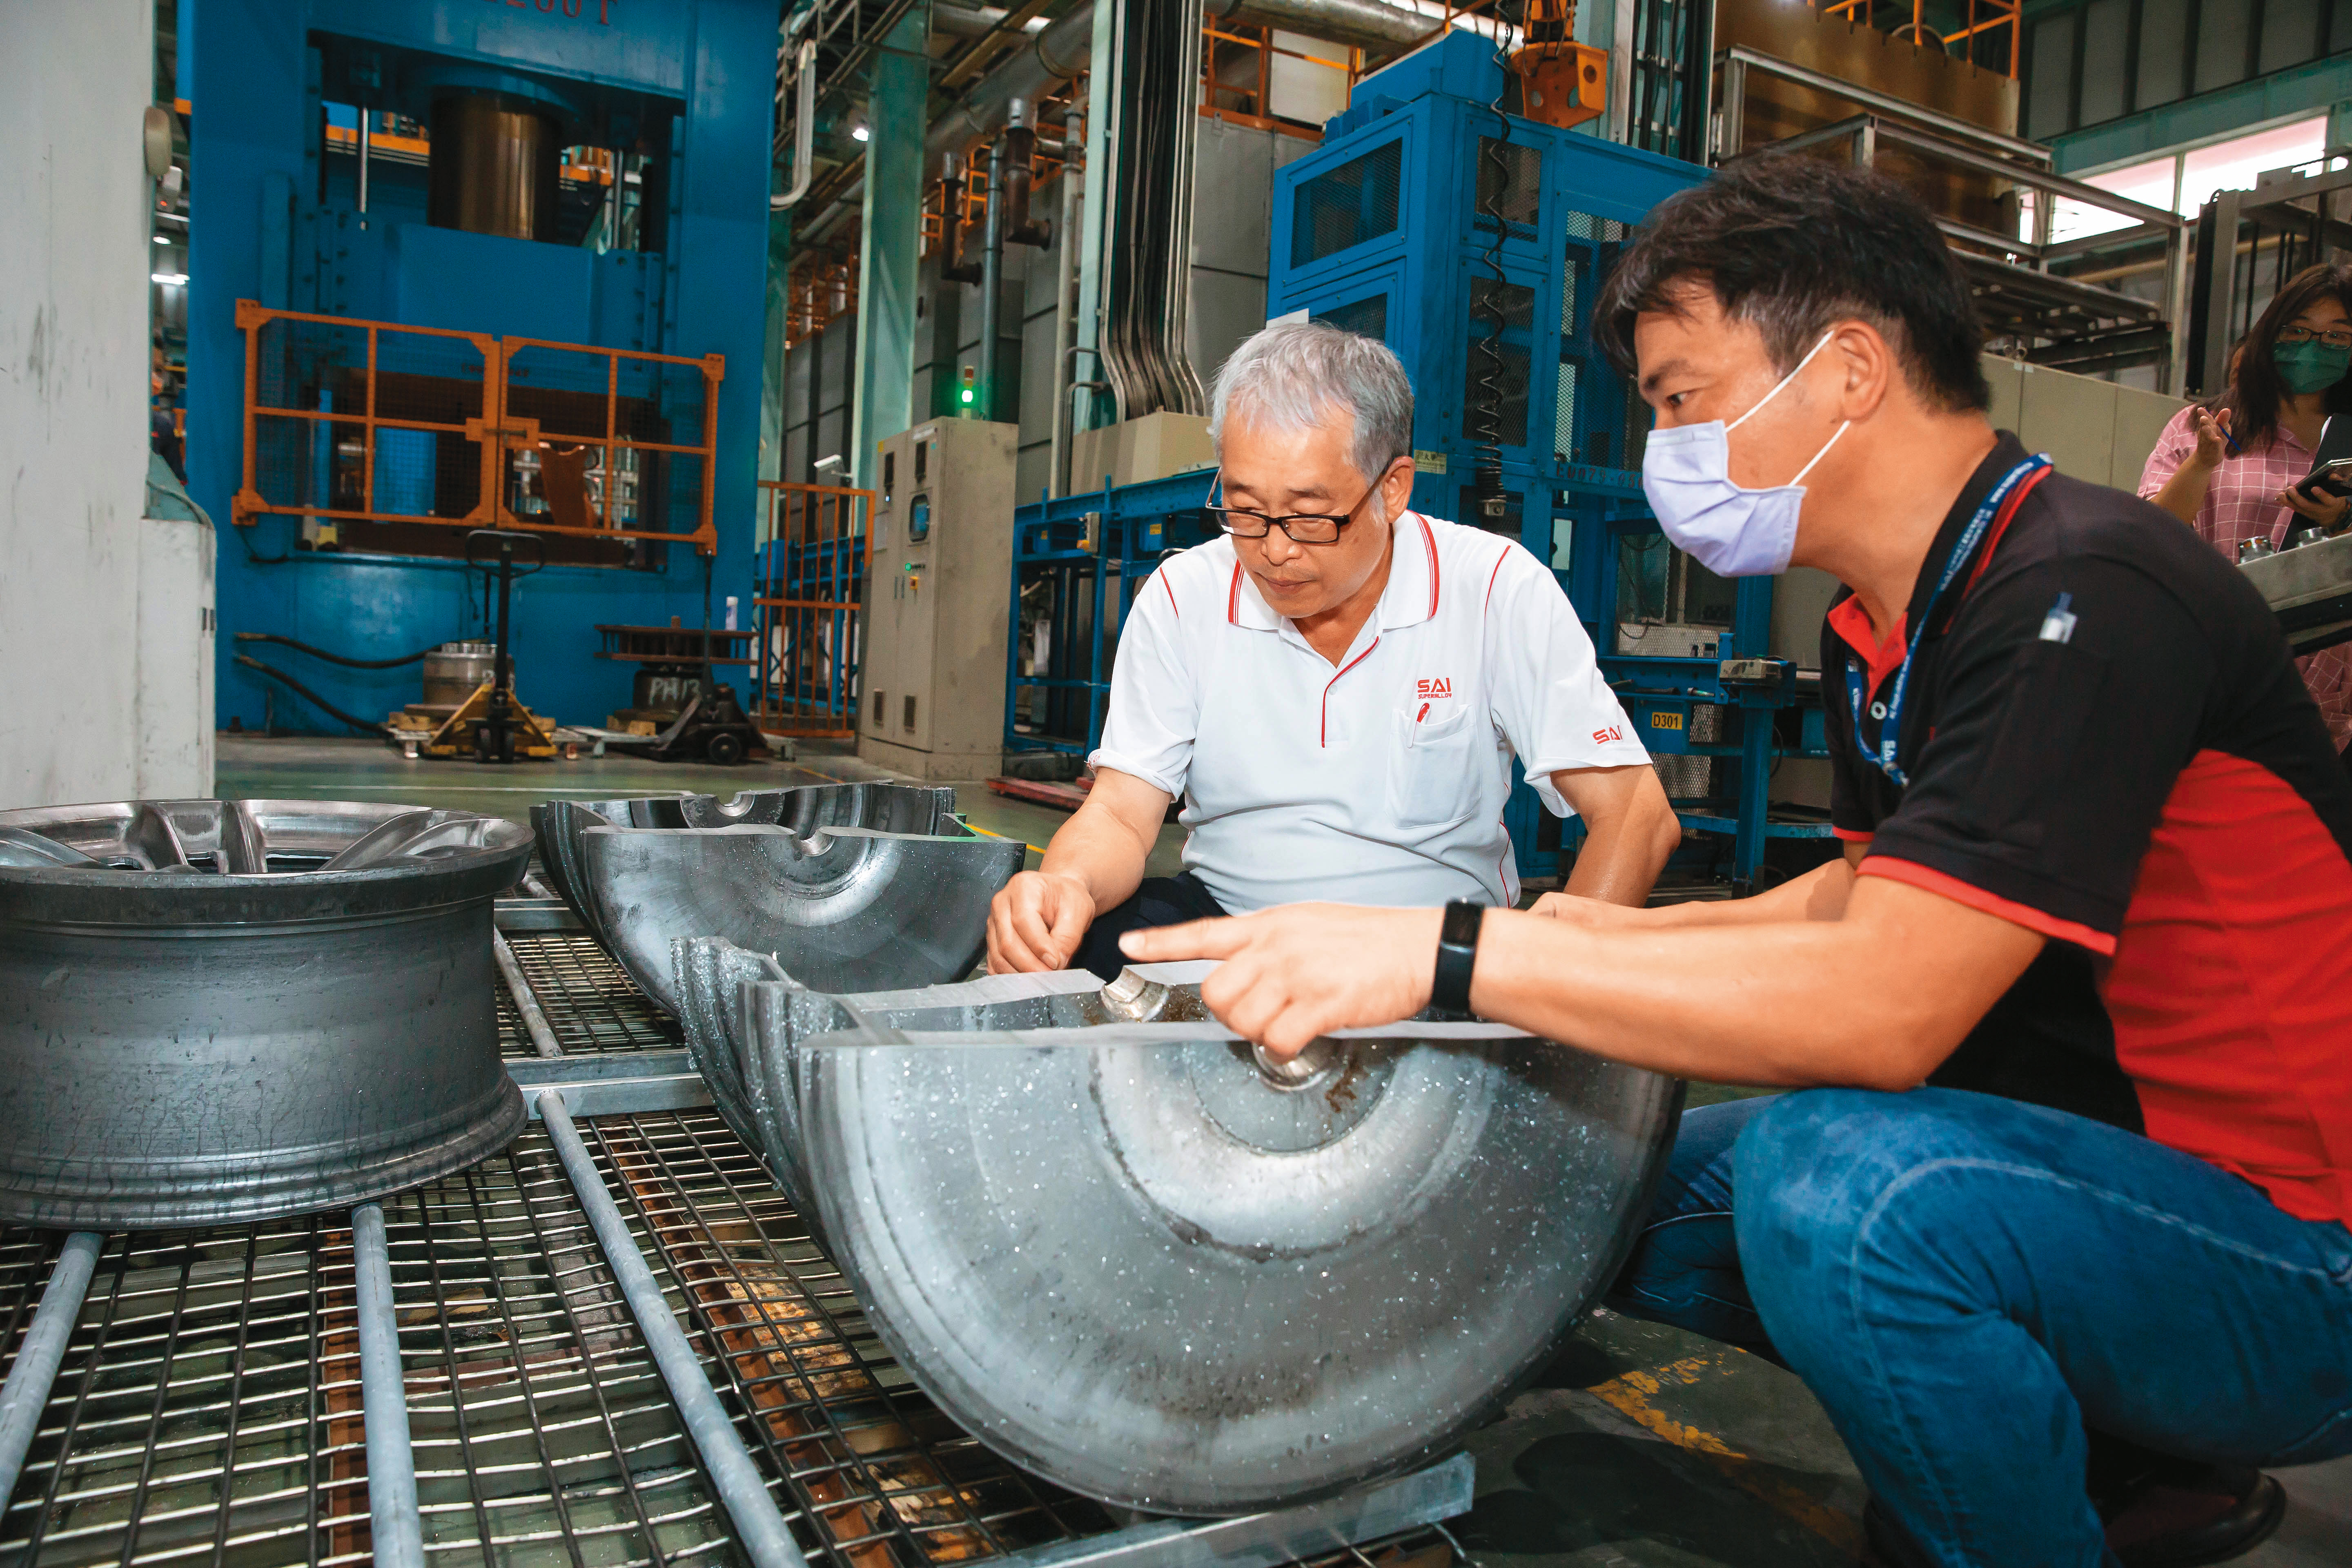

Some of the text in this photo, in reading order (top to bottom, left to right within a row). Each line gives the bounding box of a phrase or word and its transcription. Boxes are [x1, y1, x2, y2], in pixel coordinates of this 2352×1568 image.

[1417, 677, 1451, 693] SAI
[1653, 714, 1678, 728] D301
[1592, 724, 1623, 744] SAI
